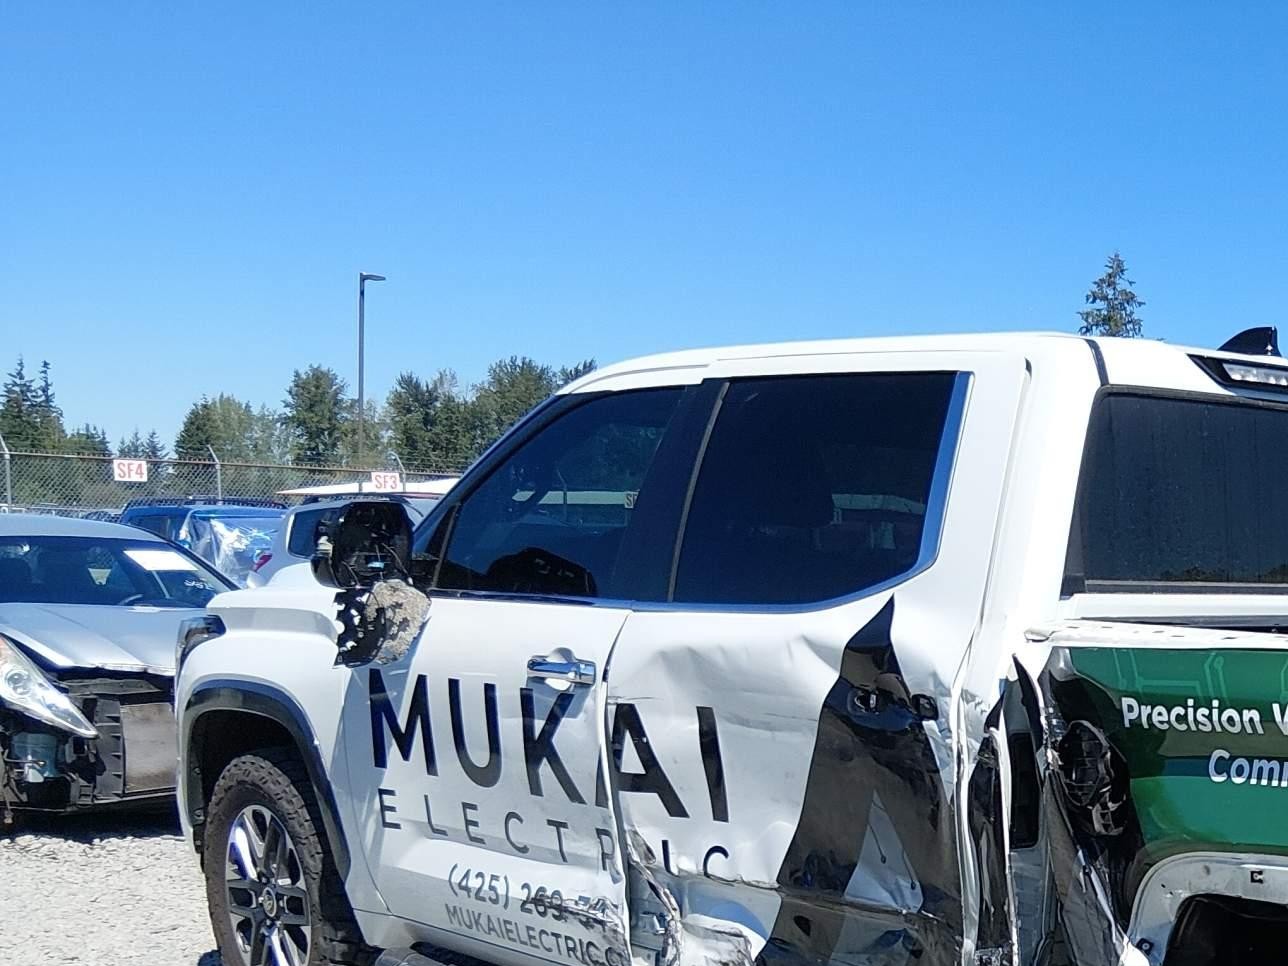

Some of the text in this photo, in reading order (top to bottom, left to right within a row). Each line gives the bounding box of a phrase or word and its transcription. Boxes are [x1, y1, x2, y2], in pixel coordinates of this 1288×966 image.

[117, 462, 145, 479] SF4
[374, 474, 398, 489] SF3
[1121, 697, 1265, 734] Precision
[368, 668, 730, 823] MUKAI
[377, 788, 730, 884] ELECTRIC
[448, 863, 511, 910] (425)
